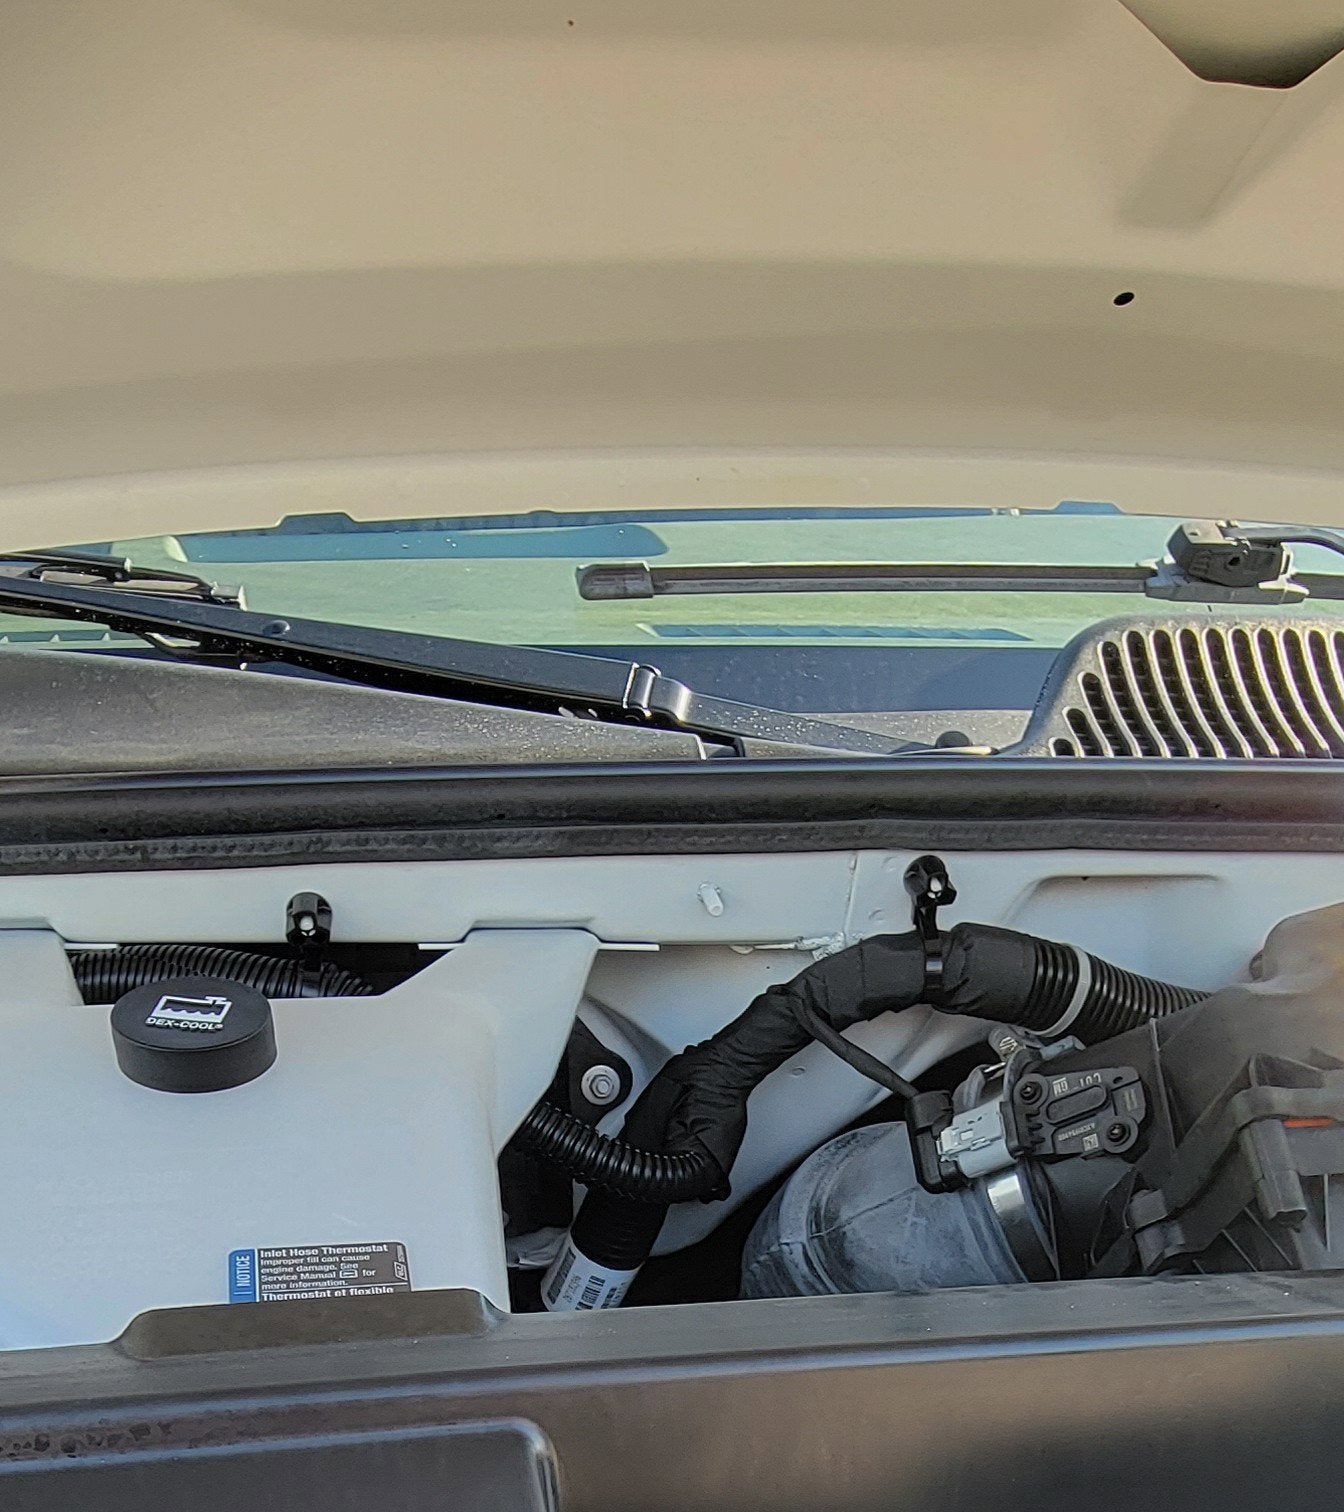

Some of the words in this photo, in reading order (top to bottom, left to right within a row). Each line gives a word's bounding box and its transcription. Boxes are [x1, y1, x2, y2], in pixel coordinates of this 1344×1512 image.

[260, 1249, 287, 1258] Inlet
[290, 1248, 319, 1256] Hose
[321, 1244, 389, 1254] Thermostat
[260, 1258, 304, 1266] Improper
[236, 1255, 251, 1287] NOTICE
[261, 1266, 294, 1274] engine
[296, 1264, 337, 1272] damage.
[300, 1272, 336, 1280] Manual
[289, 1280, 348, 1288] information.
[262, 1290, 332, 1301] Thermostat
[334, 1289, 346, 1297] et
[349, 1286, 394, 1296] flexible
